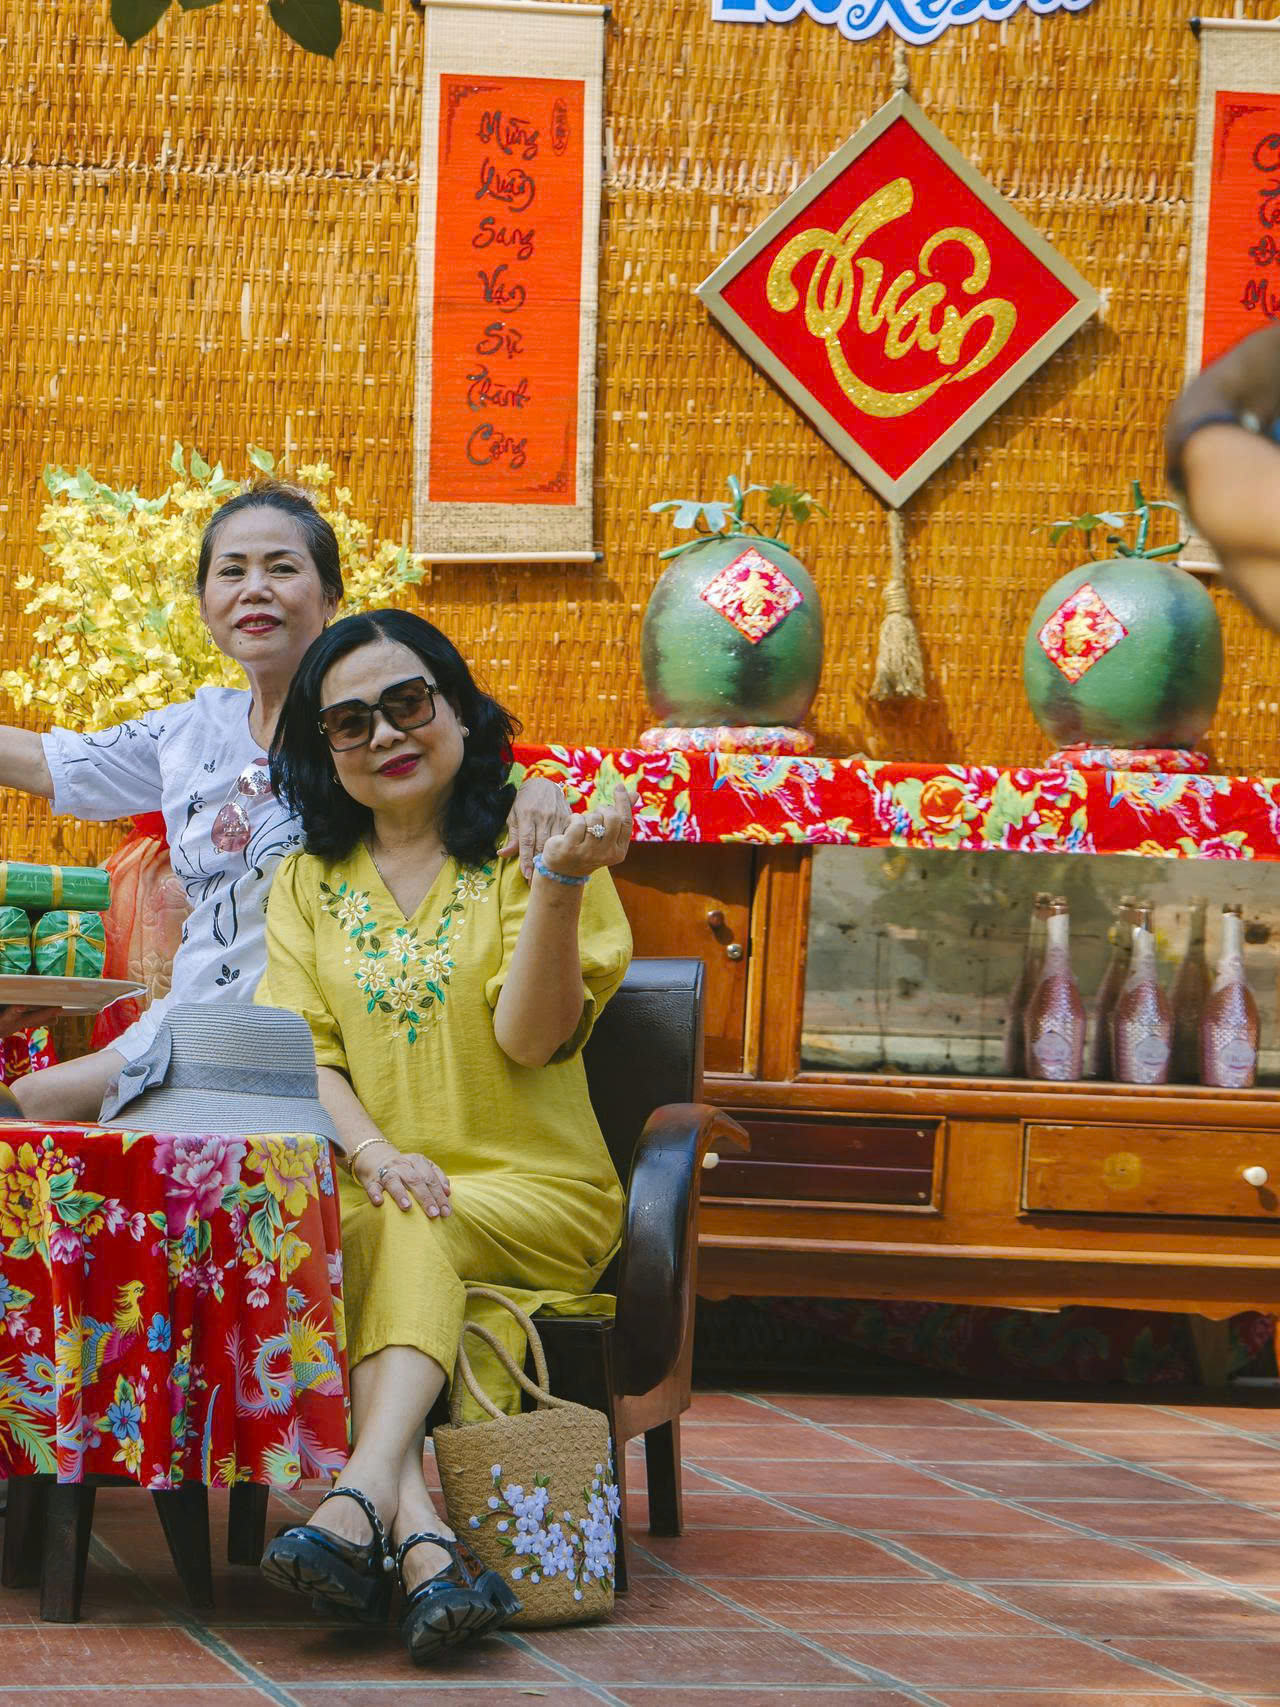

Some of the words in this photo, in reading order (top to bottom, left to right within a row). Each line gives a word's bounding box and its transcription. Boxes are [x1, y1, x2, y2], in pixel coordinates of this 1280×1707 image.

[472, 216, 535, 260] Sang
[478, 264, 526, 313] Vạn
[766, 177, 1017, 417] Xuân
[475, 321, 524, 359] Sự
[466, 364, 531, 412] Thành
[466, 423, 528, 469] Công
